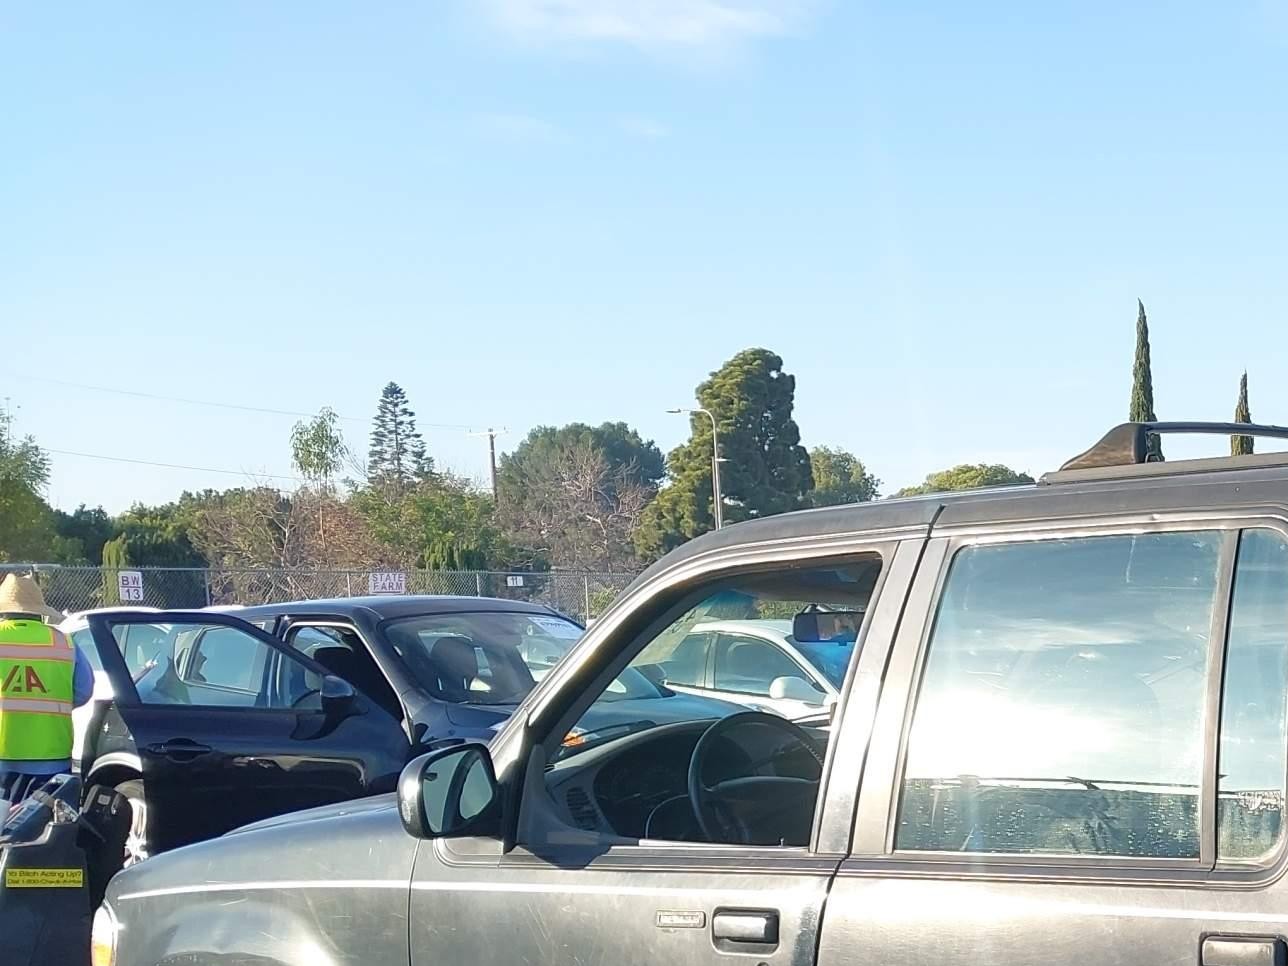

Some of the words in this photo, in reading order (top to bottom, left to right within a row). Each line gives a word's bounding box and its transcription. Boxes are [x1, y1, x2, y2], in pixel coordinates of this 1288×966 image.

[121, 575, 140, 586] BW
[372, 573, 405, 582] STATE
[373, 582, 403, 591] FARM
[126, 588, 140, 600] 13
